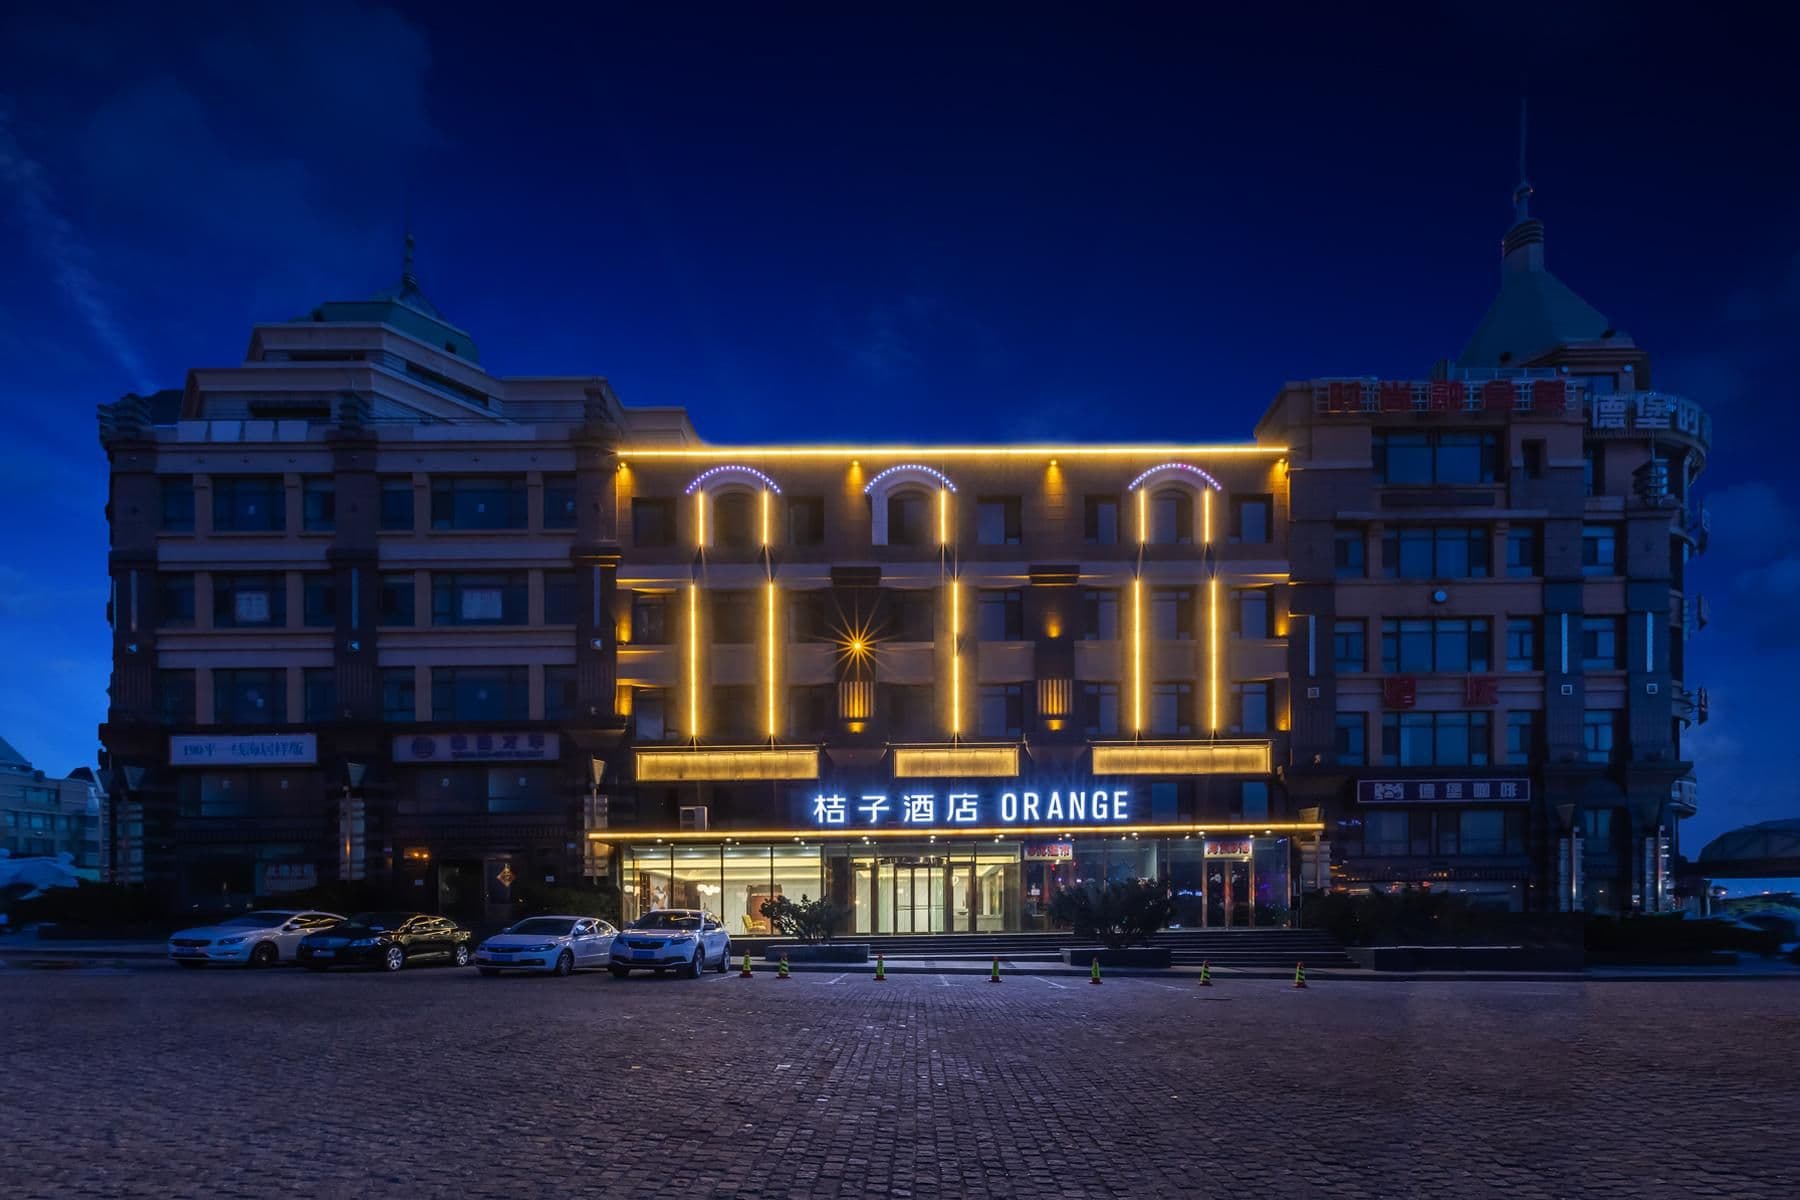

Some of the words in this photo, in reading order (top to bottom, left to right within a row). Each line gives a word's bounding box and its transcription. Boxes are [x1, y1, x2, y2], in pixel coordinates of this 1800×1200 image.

[813, 793, 979, 823] 桔子酒店
[1001, 790, 1129, 821] ORANGE
